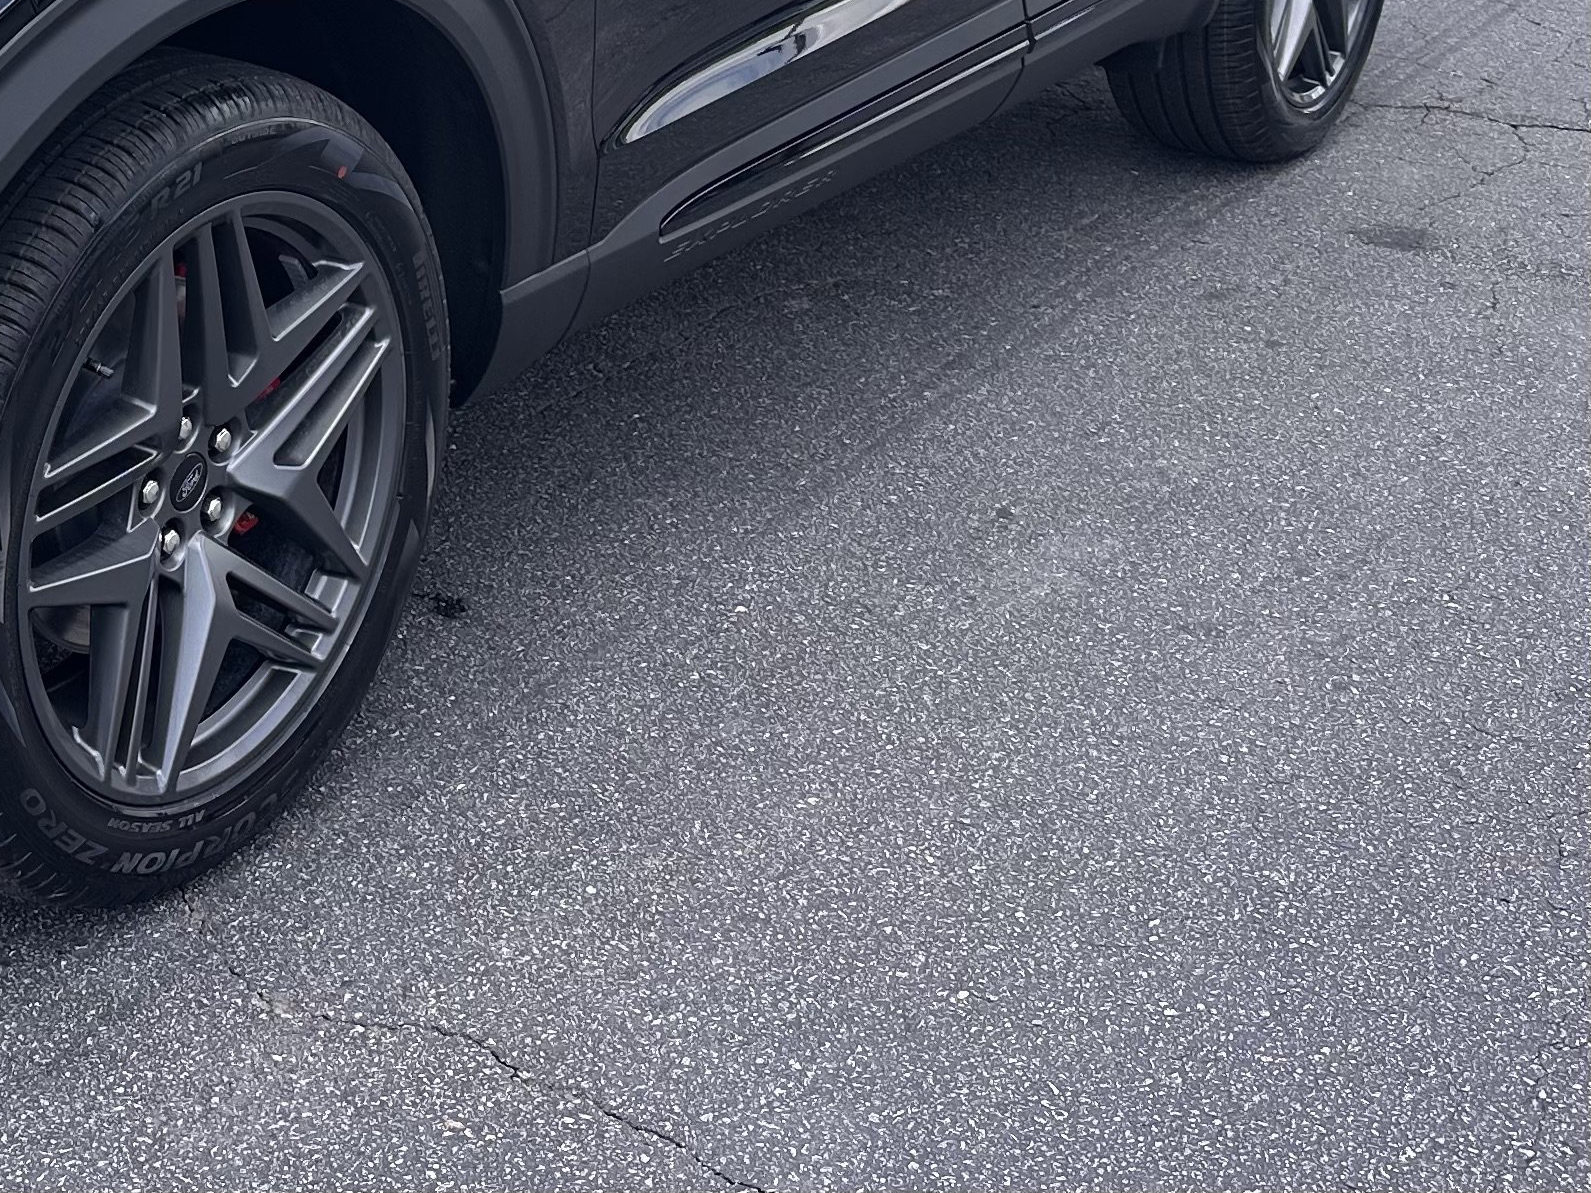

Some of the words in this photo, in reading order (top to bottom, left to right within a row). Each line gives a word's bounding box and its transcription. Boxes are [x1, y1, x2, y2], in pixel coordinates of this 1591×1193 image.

[19, 787, 109, 866] ZERO
[107, 815, 174, 834] SEASON
[178, 808, 207, 830] ALL
